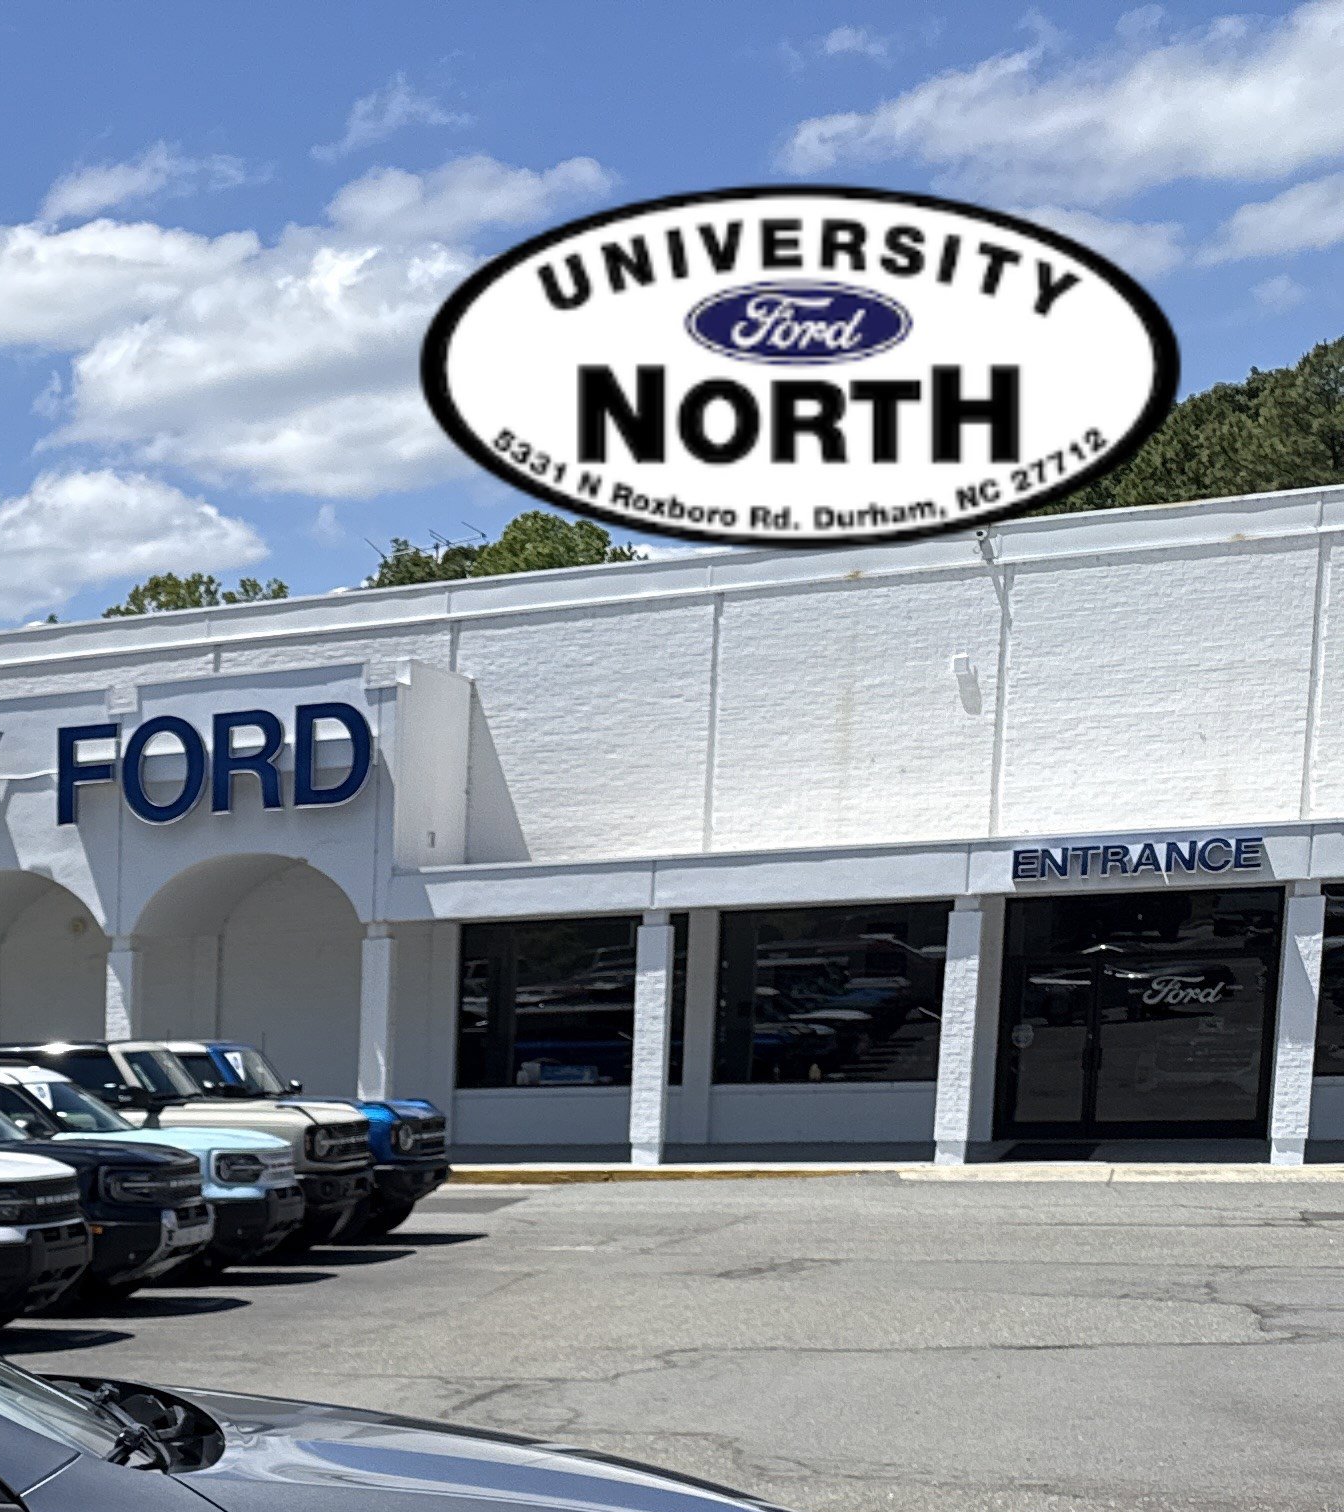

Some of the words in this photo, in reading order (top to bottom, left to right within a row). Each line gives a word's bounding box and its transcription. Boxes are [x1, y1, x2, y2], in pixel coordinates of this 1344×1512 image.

[55, 701, 374, 826] FORD
[1012, 837, 1264, 880] ENTRANCE
[1143, 976, 1224, 1005] Ford
